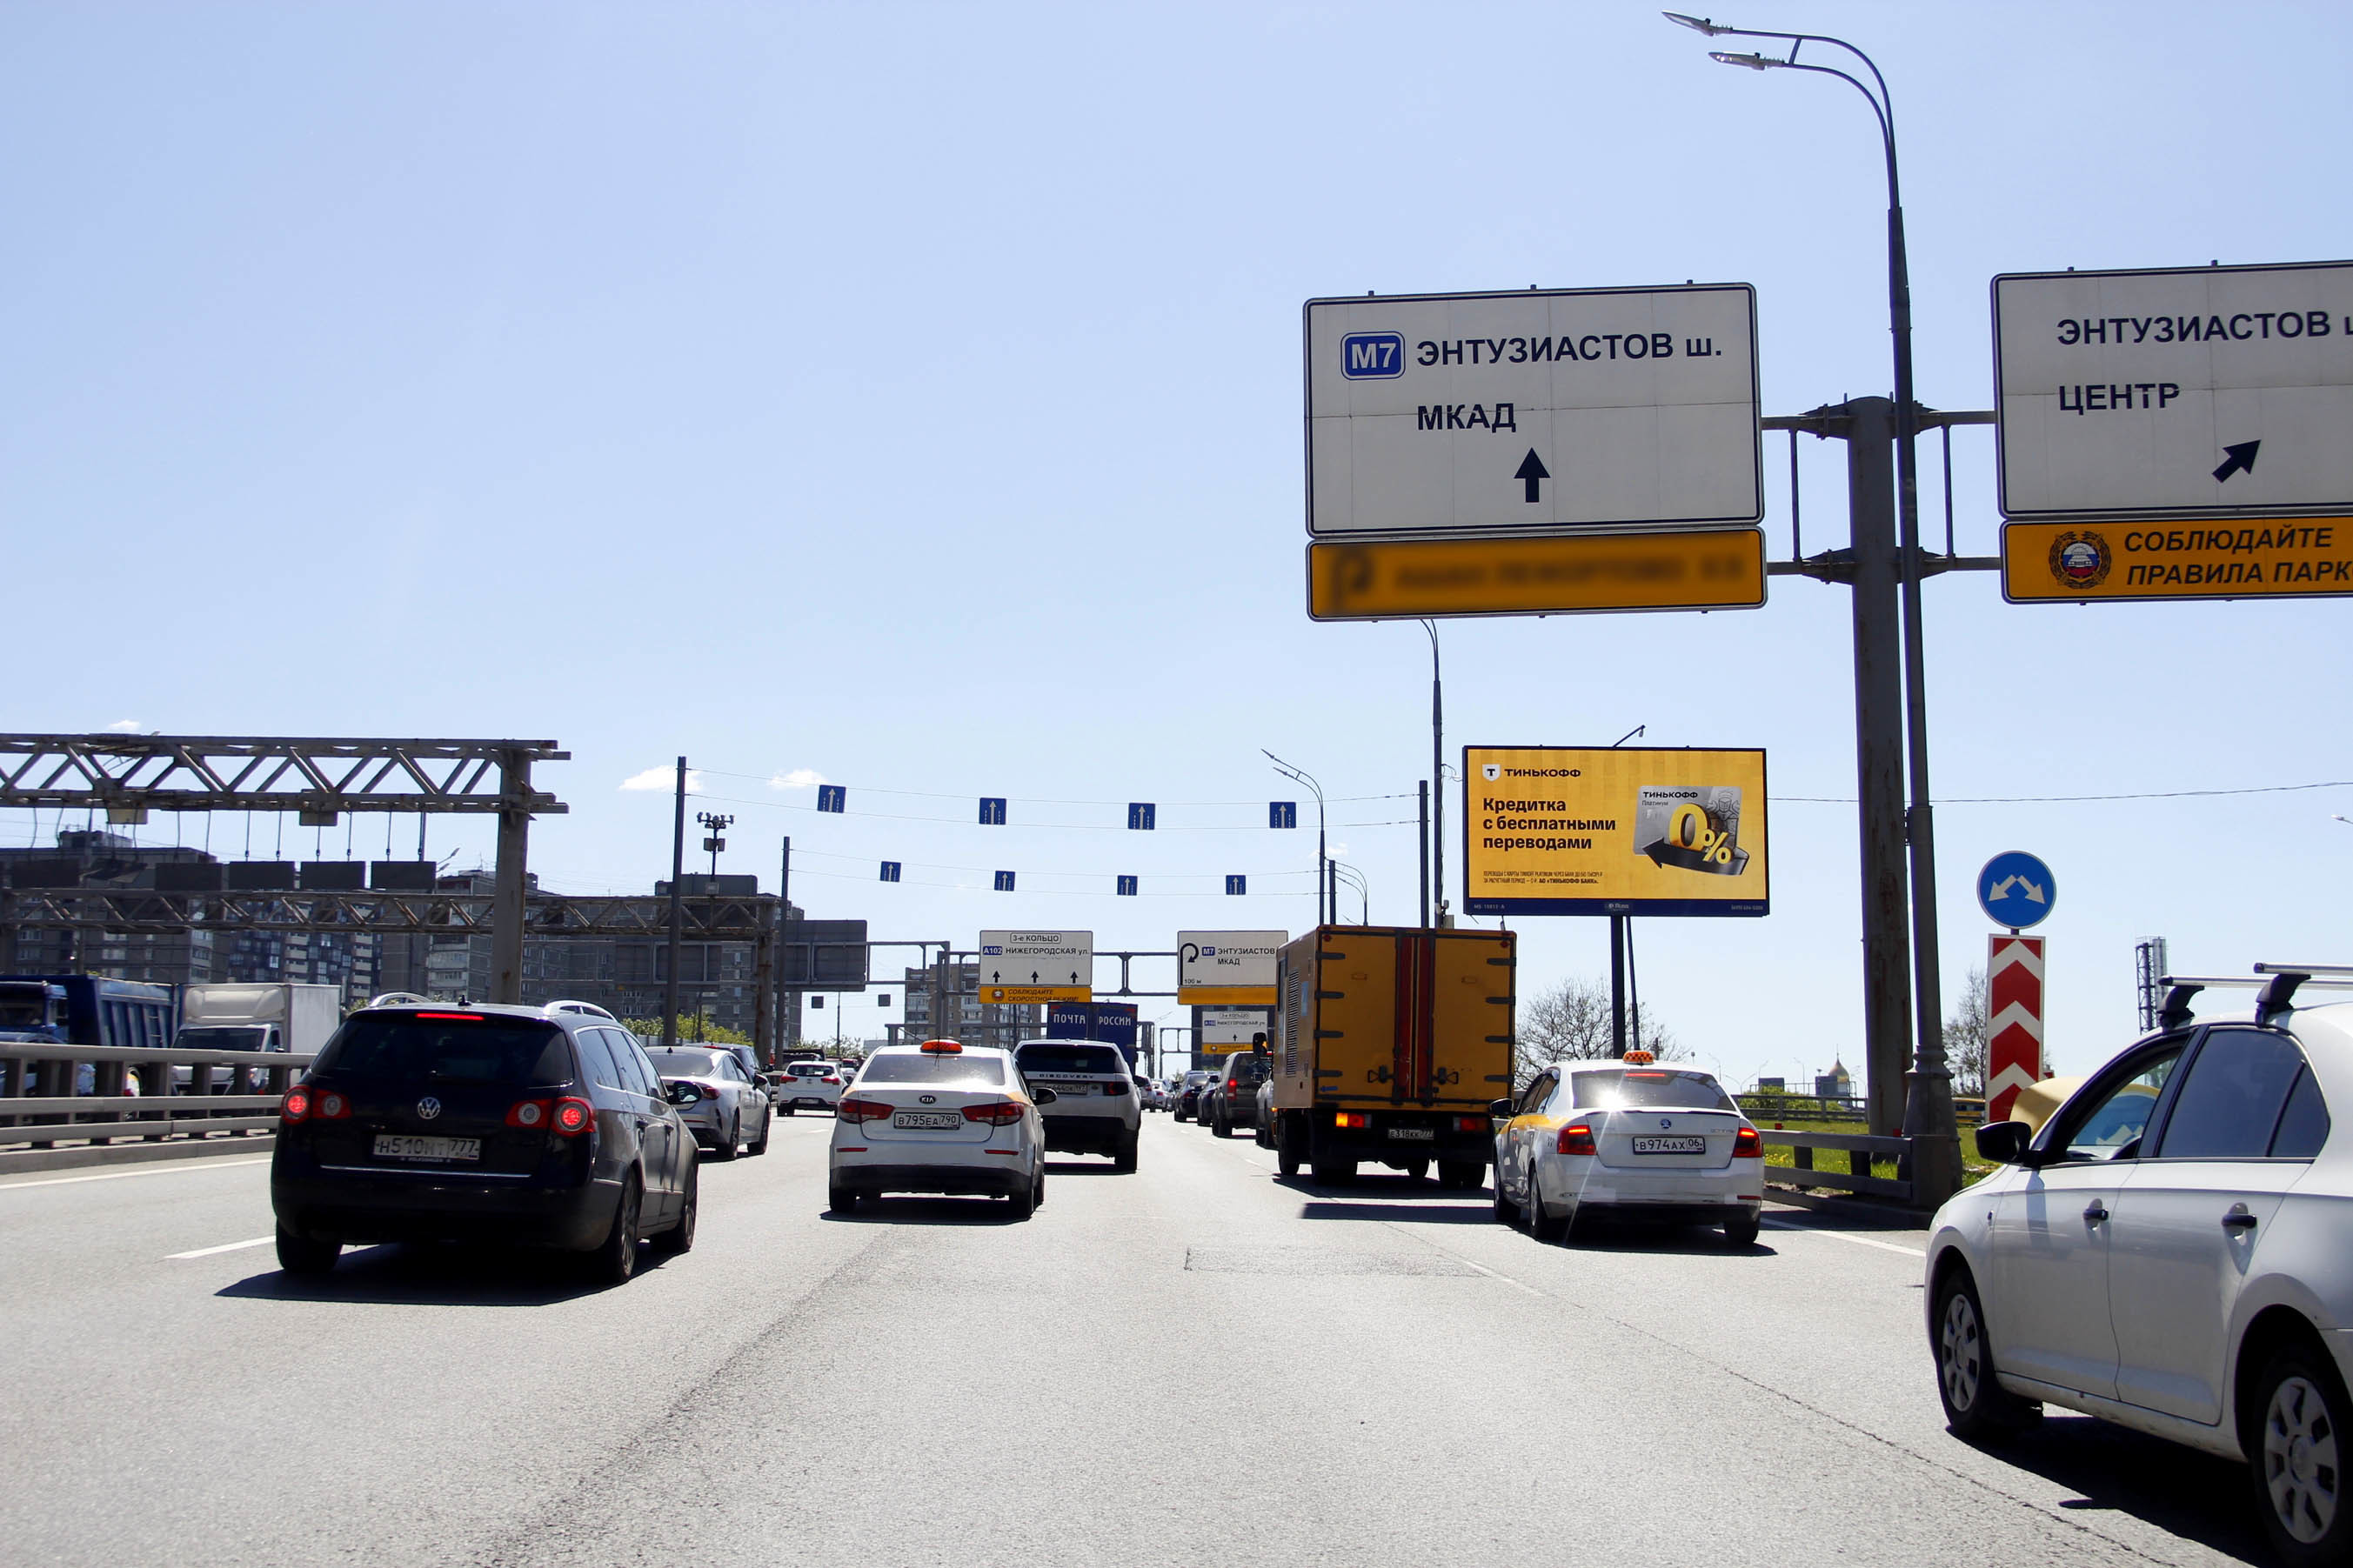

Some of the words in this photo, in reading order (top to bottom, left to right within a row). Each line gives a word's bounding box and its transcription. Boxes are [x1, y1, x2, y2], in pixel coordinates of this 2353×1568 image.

[2057, 310, 2330, 345] ЭНТУЗИАСТОВ
[1351, 342, 1395, 370] М7
[1416, 332, 1674, 366] ЭНТУЗИАСТОВ
[1686, 337, 1722, 358] ш.
[2058, 383, 2181, 416] ЦЕНТР
[1417, 403, 1517, 433] МКАД
[2124, 524, 2335, 555] СОБЛЮДАЙТЕ
[2126, 564, 2263, 586] ПРАВИЛА
[2273, 561, 2353, 583] ПАРК
[1504, 769, 1581, 777] ТИНЬКОФФ
[1483, 797, 1567, 814] Кредитка
[1482, 818, 1494, 830] с
[1496, 816, 1616, 831] бесплатными
[1483, 837, 1592, 851] переводами
[1053, 1013, 1086, 1024] ПОЧТА
[1099, 1016, 1131, 1026] РОССИИ
[899, 1115, 939, 1125] В795ЕА
[1640, 1138, 1686, 1151] В974АХ
[1688, 1138, 1700, 1147] 06
